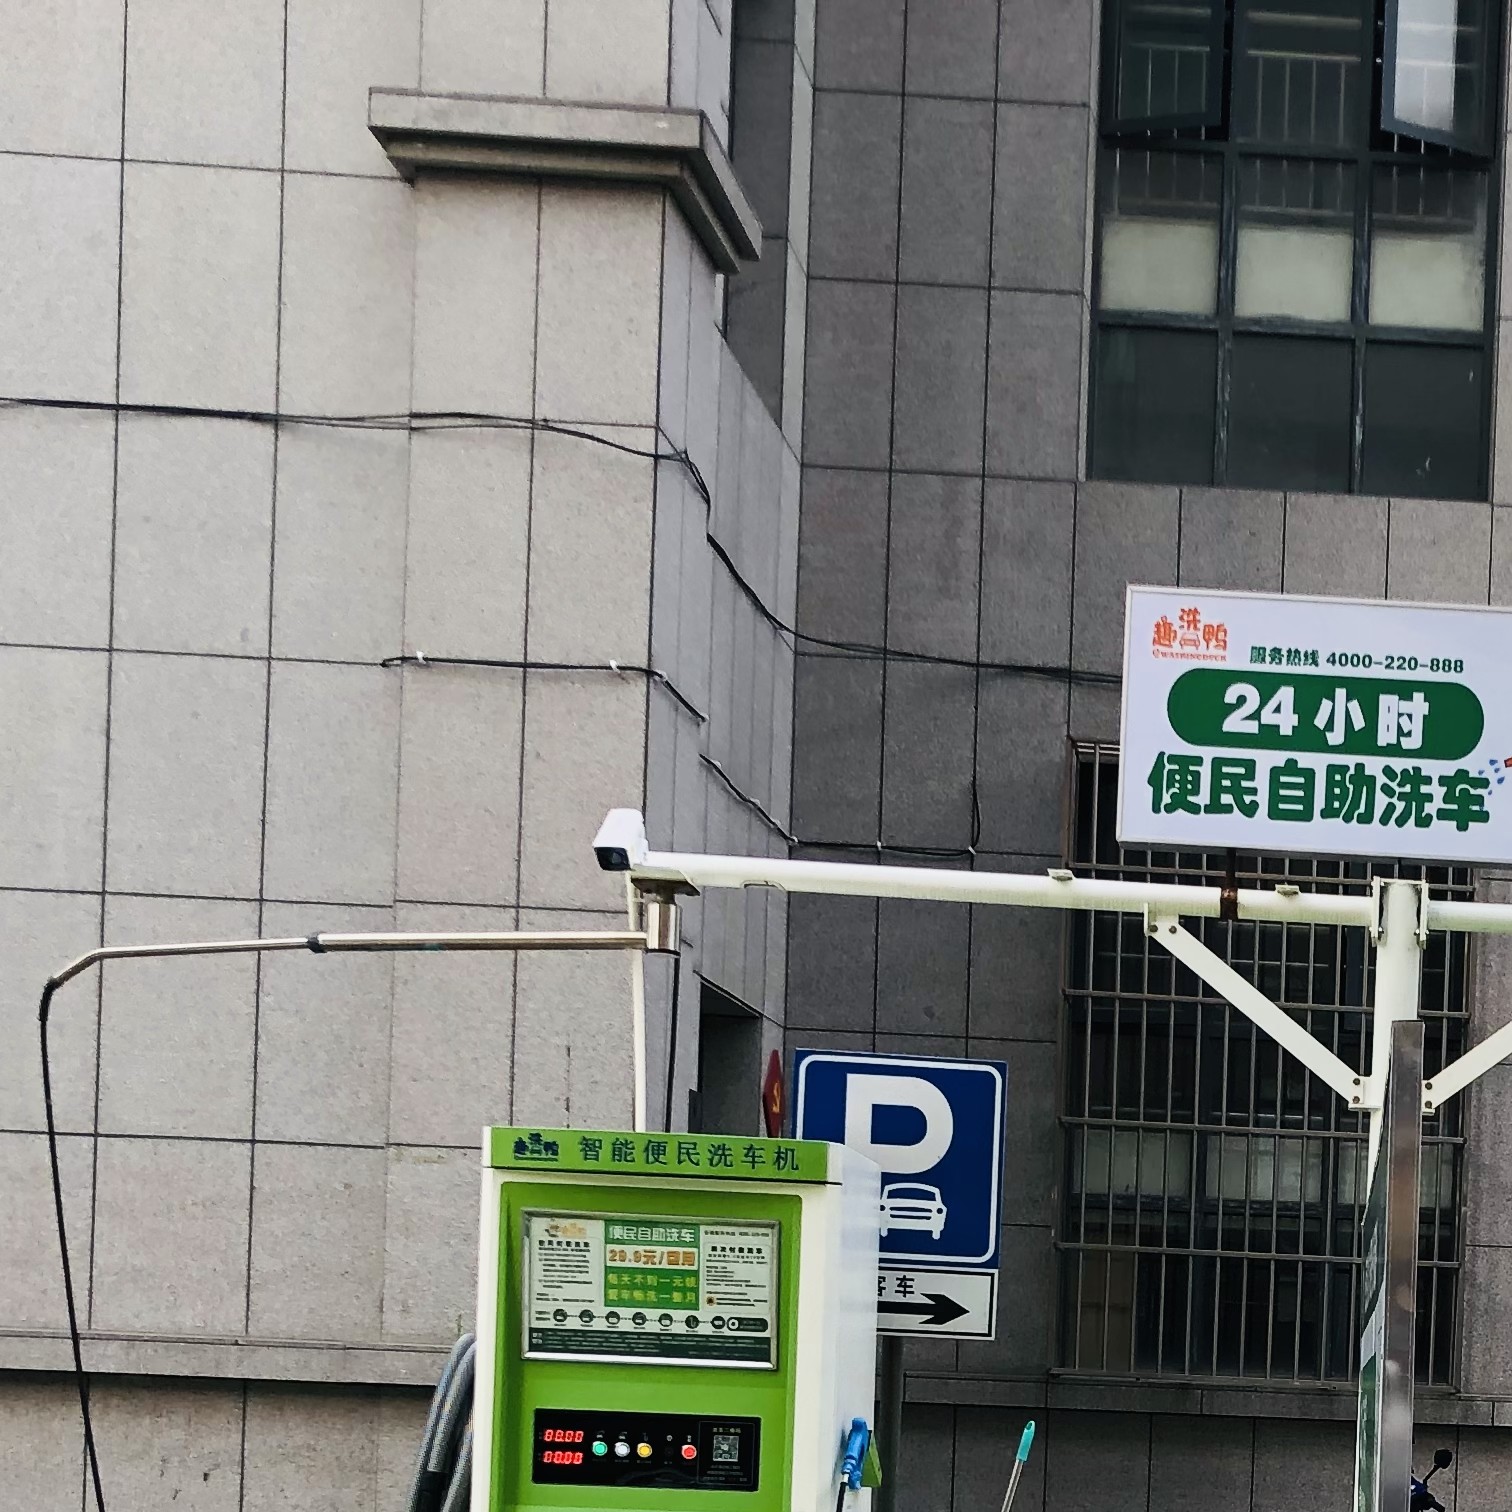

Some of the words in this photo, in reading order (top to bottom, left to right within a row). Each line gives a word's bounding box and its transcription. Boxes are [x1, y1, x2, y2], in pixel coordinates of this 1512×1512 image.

[1250, 646, 1319, 667] 服务热线
[1326, 652, 1464, 673] 4000-220-888
[1147, 751, 1490, 831] 便民自助洗车
[845, 1073, 954, 1174] P
[579, 1136, 800, 1171] 智能便民洗车机
[609, 1225, 695, 1242] 便民自助洗车
